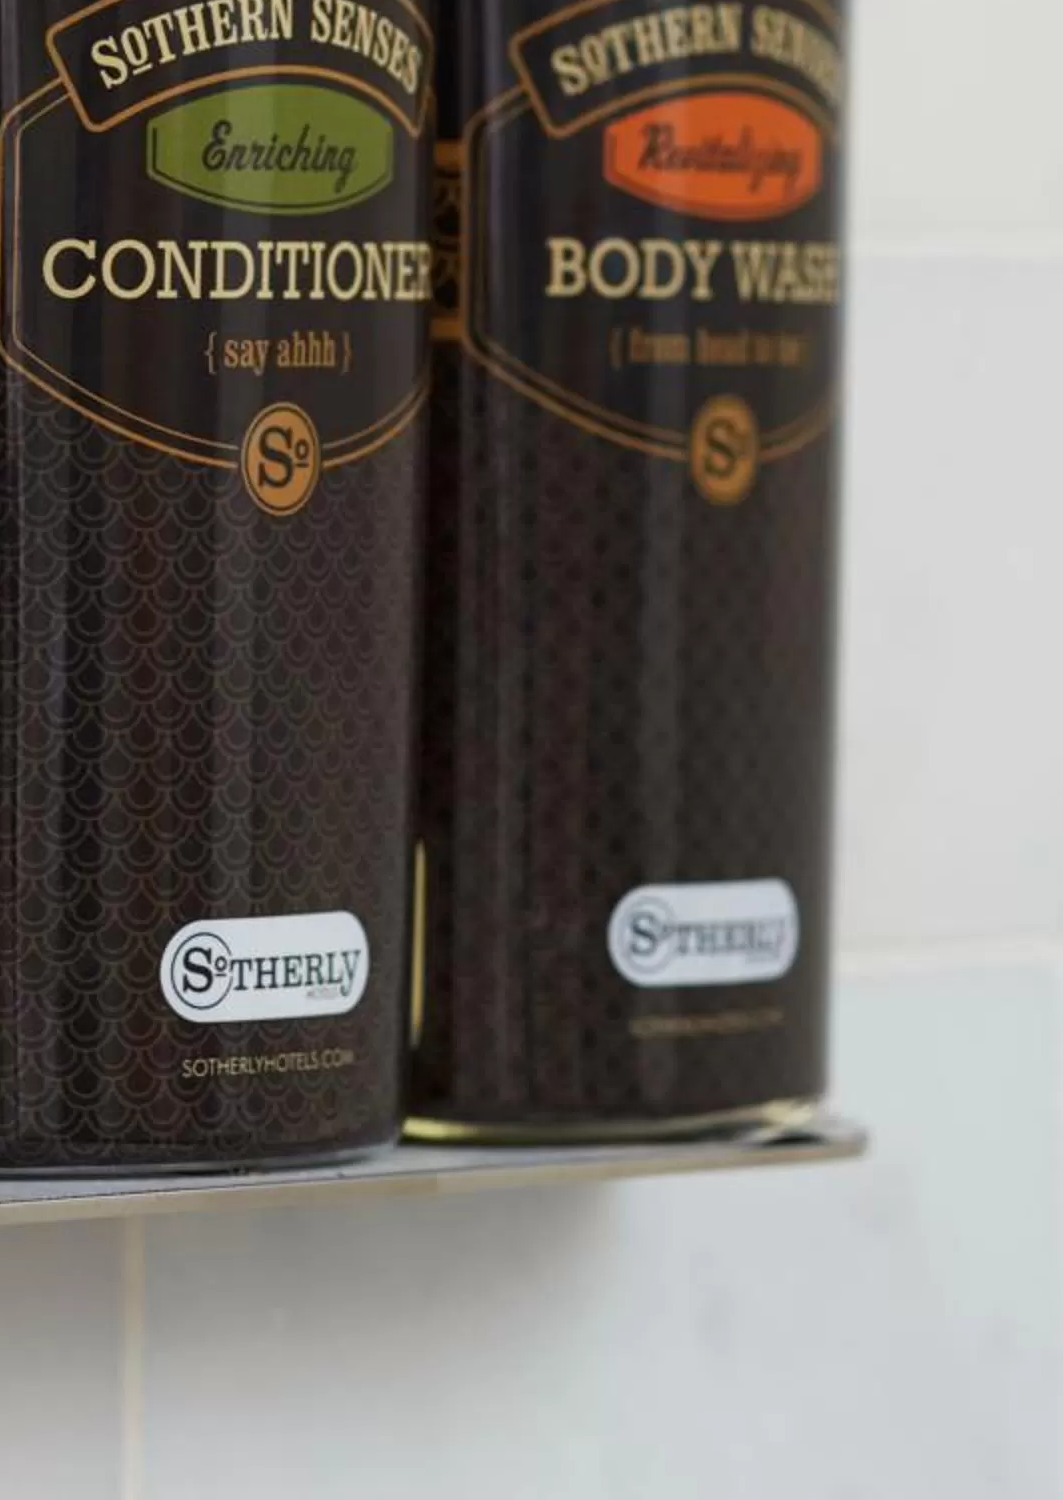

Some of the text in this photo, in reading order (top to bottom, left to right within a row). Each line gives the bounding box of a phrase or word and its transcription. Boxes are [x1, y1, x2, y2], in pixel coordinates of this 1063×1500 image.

[202, 119, 357, 193] Enriching
[42, 239, 433, 301] CONDITIONER
[545, 237, 722, 300] BODY
